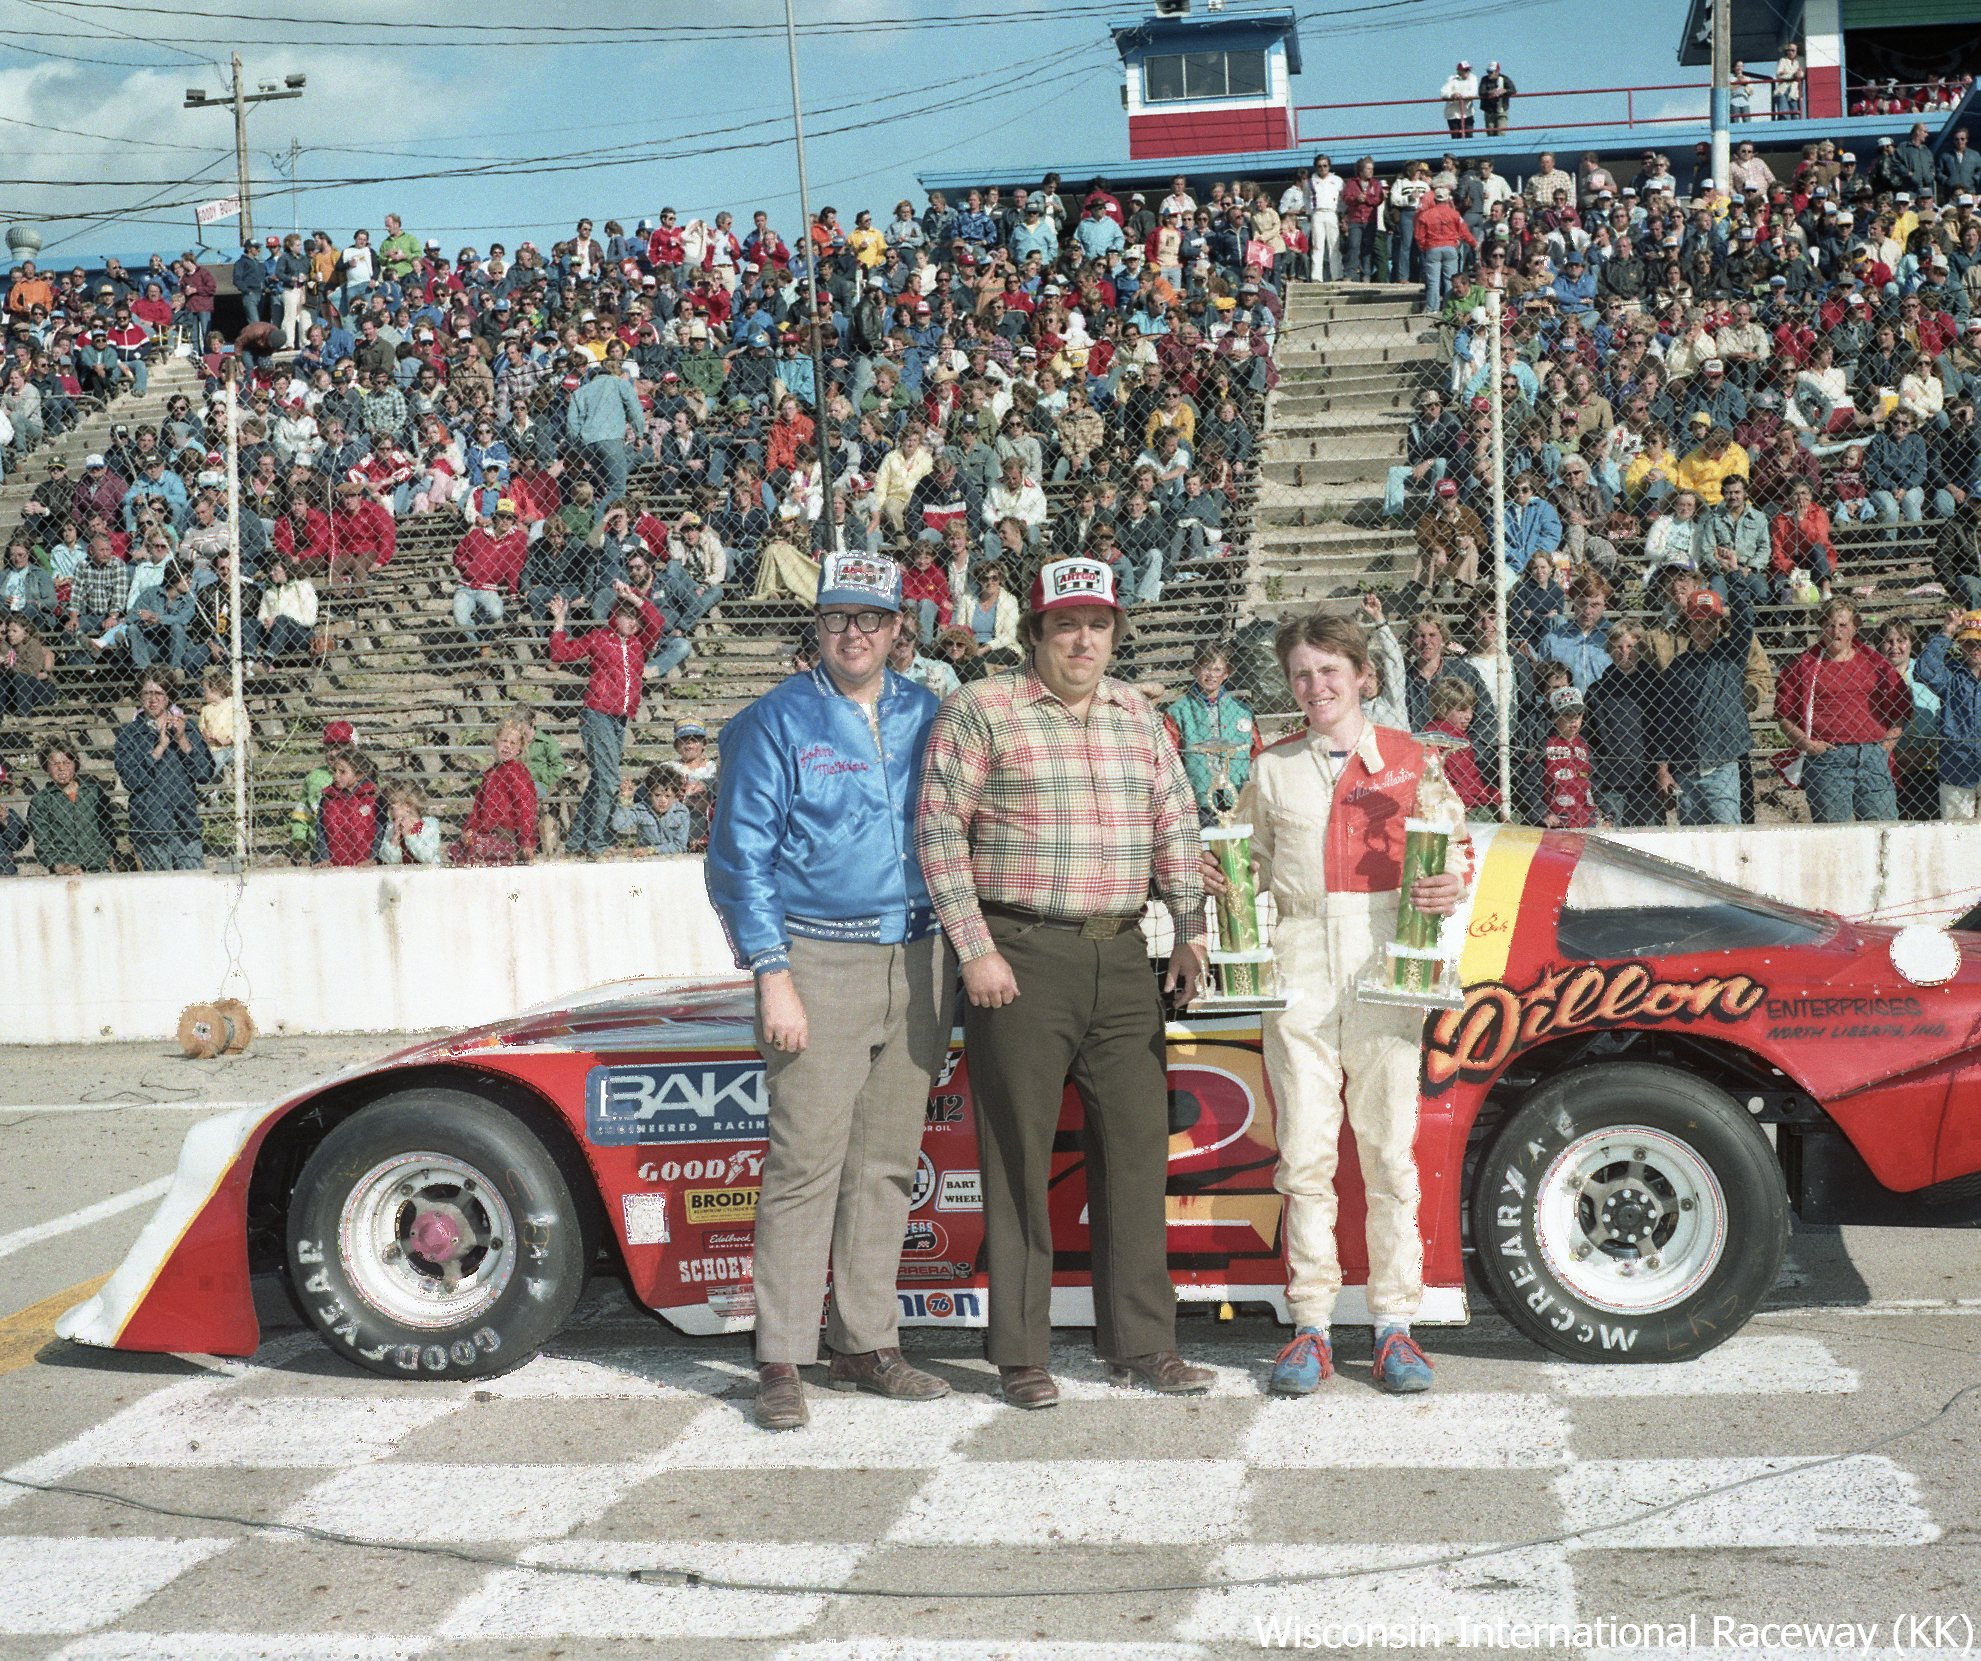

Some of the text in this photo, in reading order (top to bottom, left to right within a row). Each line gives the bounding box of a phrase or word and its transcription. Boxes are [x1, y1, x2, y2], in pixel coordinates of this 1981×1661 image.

[1766, 998, 1924, 1020] ENTERPRISES
[1423, 961, 1768, 1097] Dillon
[1766, 1026, 1825, 1041] NORTH
[713, 1120, 769, 1131] RACIN
[946, 1181, 976, 1189] BART
[709, 1233, 751, 1243] Edelbrock
[930, 1296, 949, 1311] 76
